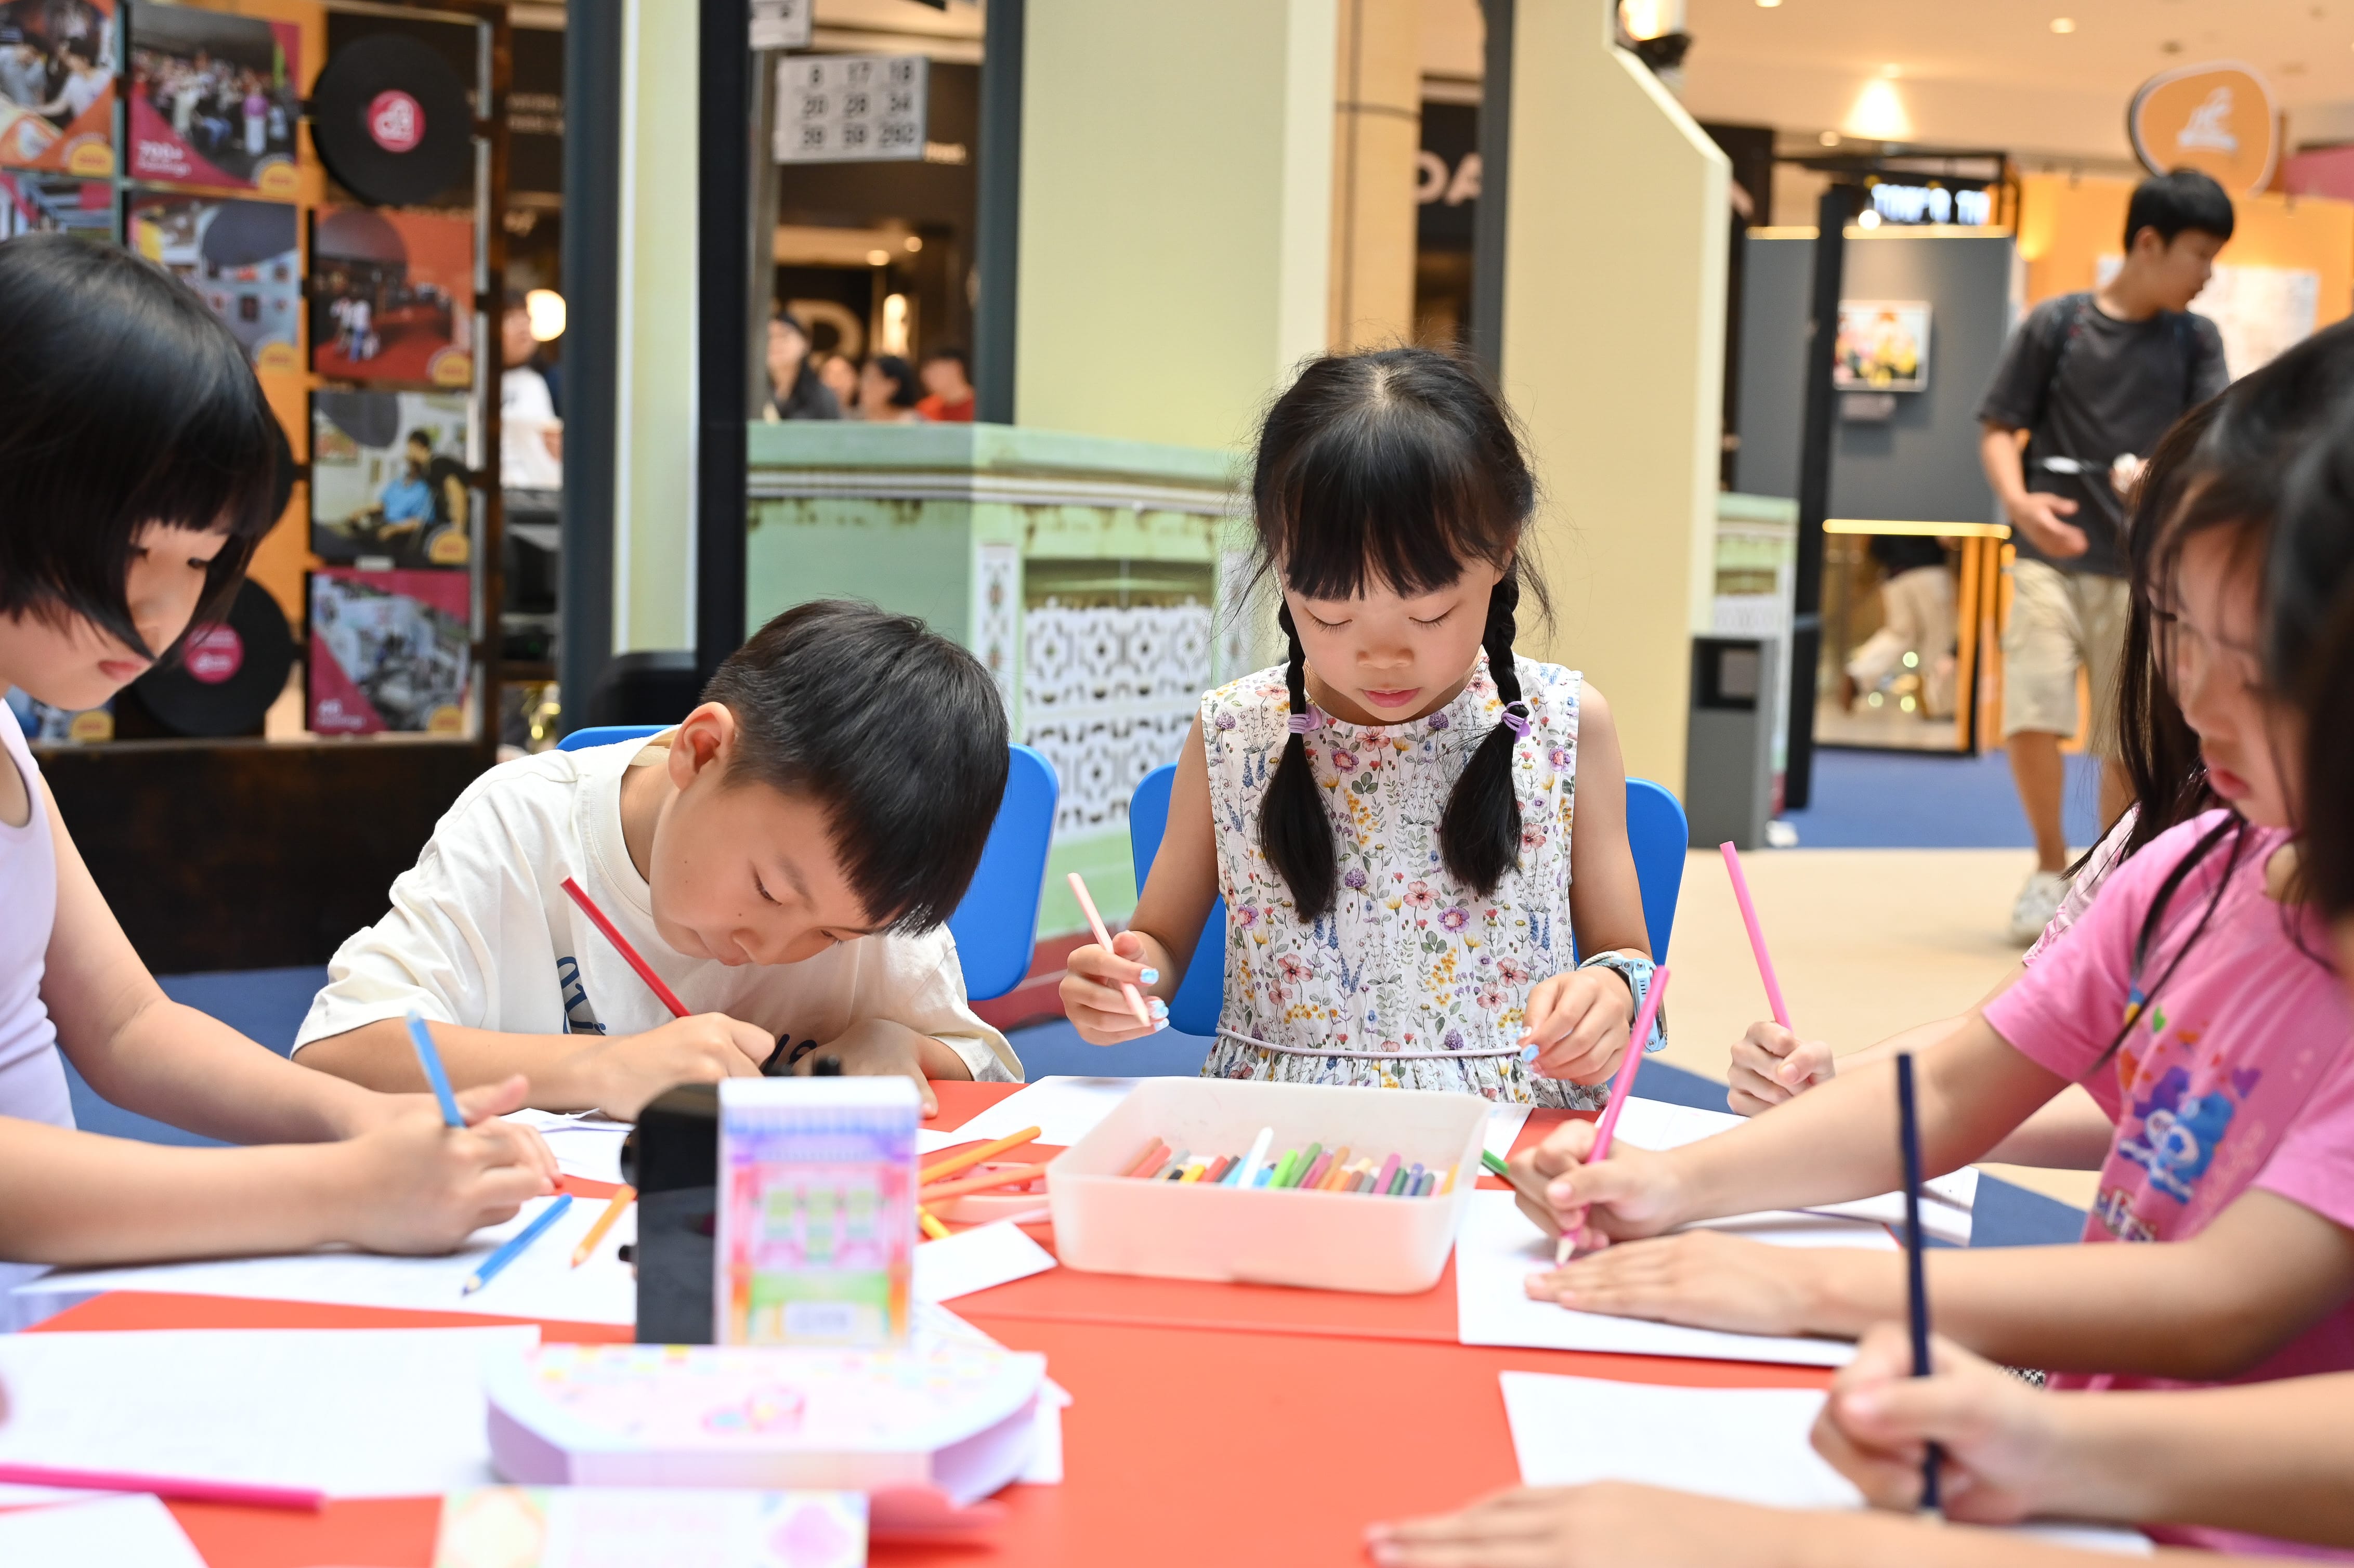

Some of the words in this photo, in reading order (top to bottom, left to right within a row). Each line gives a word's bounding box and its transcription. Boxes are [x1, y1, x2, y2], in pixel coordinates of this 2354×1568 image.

[809, 64, 825, 88] 8
[848, 62, 872, 87] 17
[890, 60, 914, 85] 18
